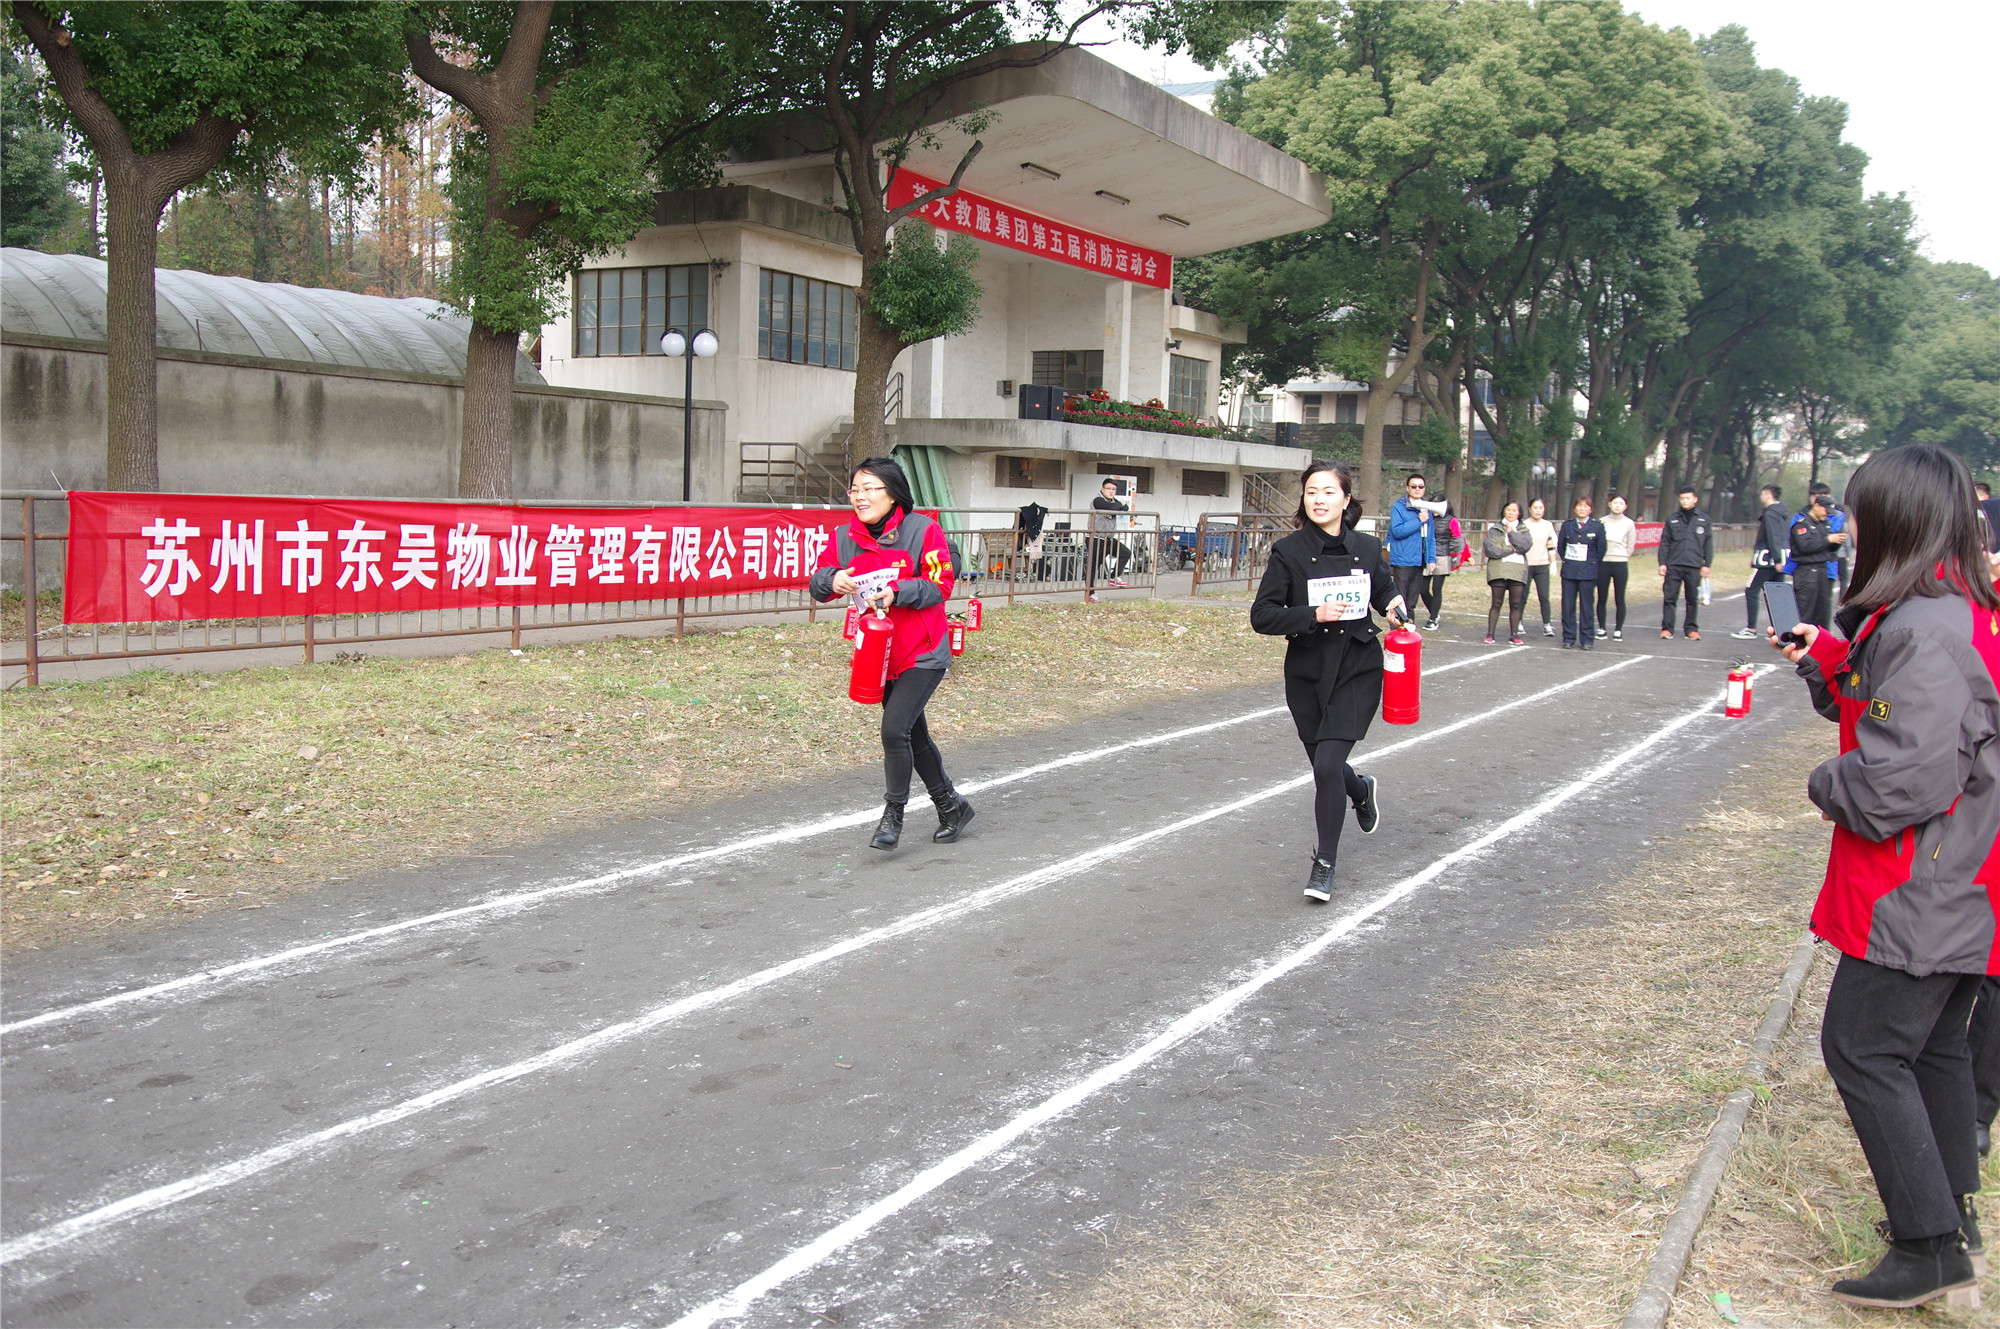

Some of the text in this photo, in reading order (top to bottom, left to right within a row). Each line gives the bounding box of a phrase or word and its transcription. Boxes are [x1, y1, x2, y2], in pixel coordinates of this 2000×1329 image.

[139, 516, 838, 597] 苏州市东吴物业管理有限公司消防
